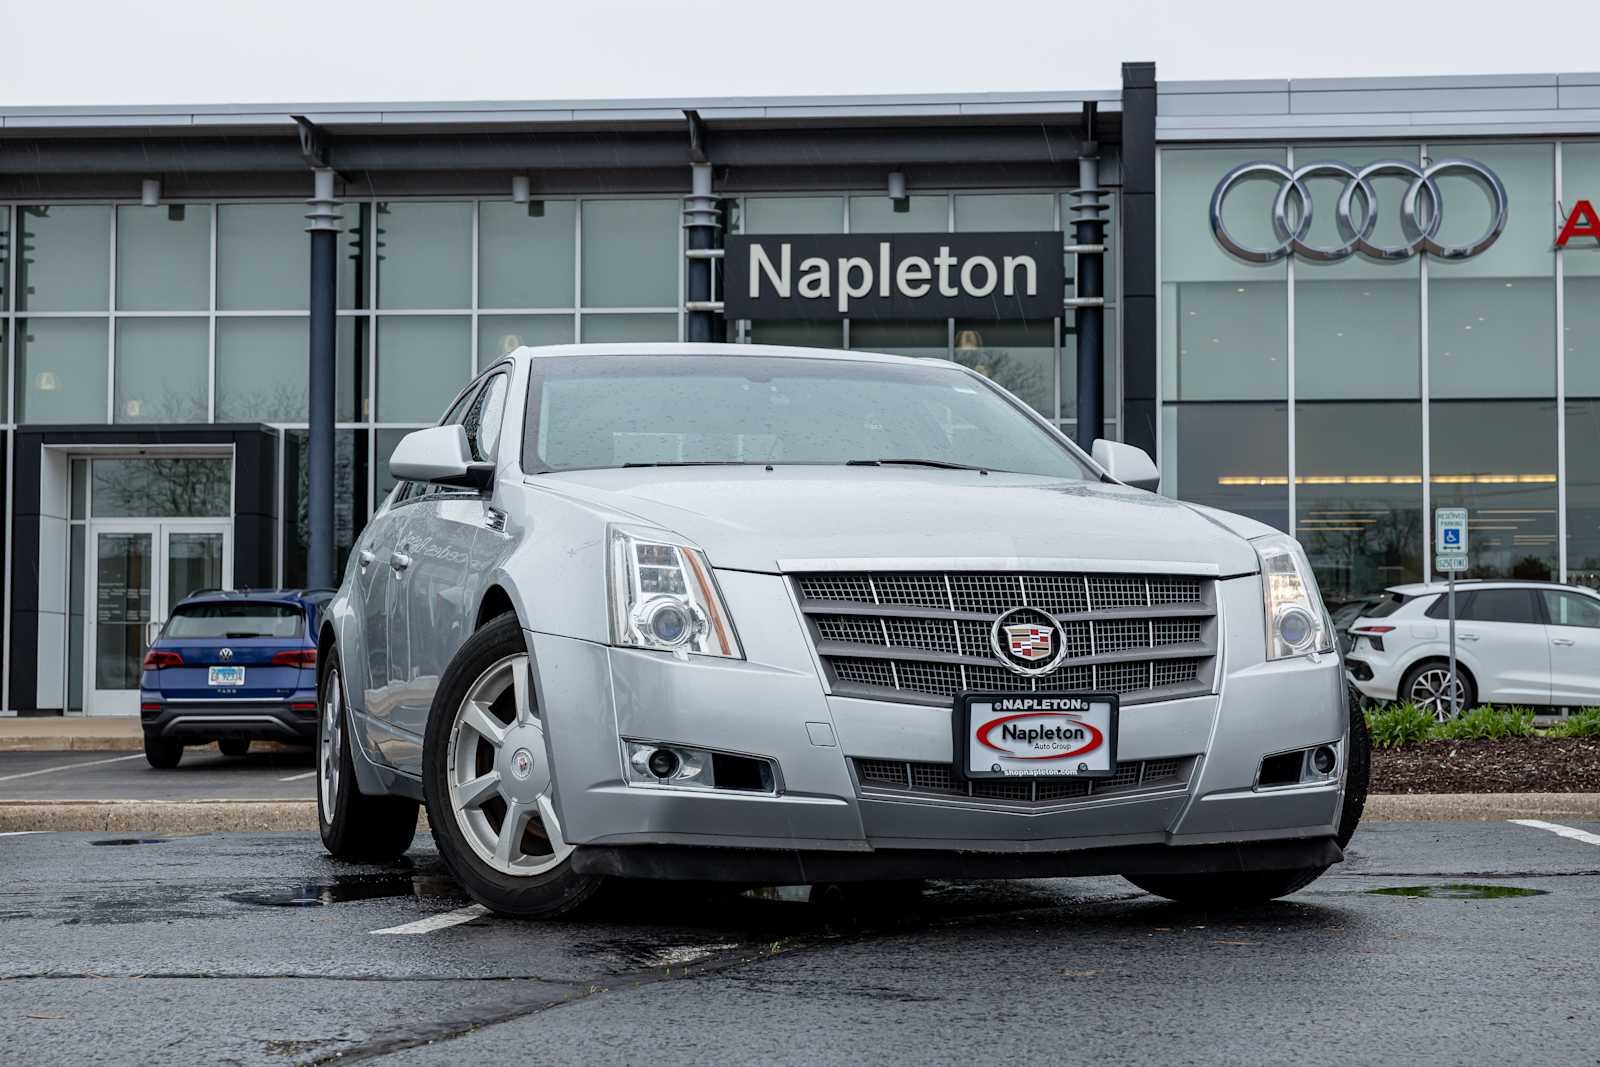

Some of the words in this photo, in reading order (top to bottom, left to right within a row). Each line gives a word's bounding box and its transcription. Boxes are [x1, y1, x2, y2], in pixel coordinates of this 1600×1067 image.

[749, 242, 1037, 312] Napleton
[1002, 699, 1082, 710] NAPLETON
[1002, 724, 1084, 743] Napleton
[1034, 742, 1050, 750] Auto
[1051, 742, 1072, 751] Group
[1004, 768, 1078, 776] shopnapleton.com
